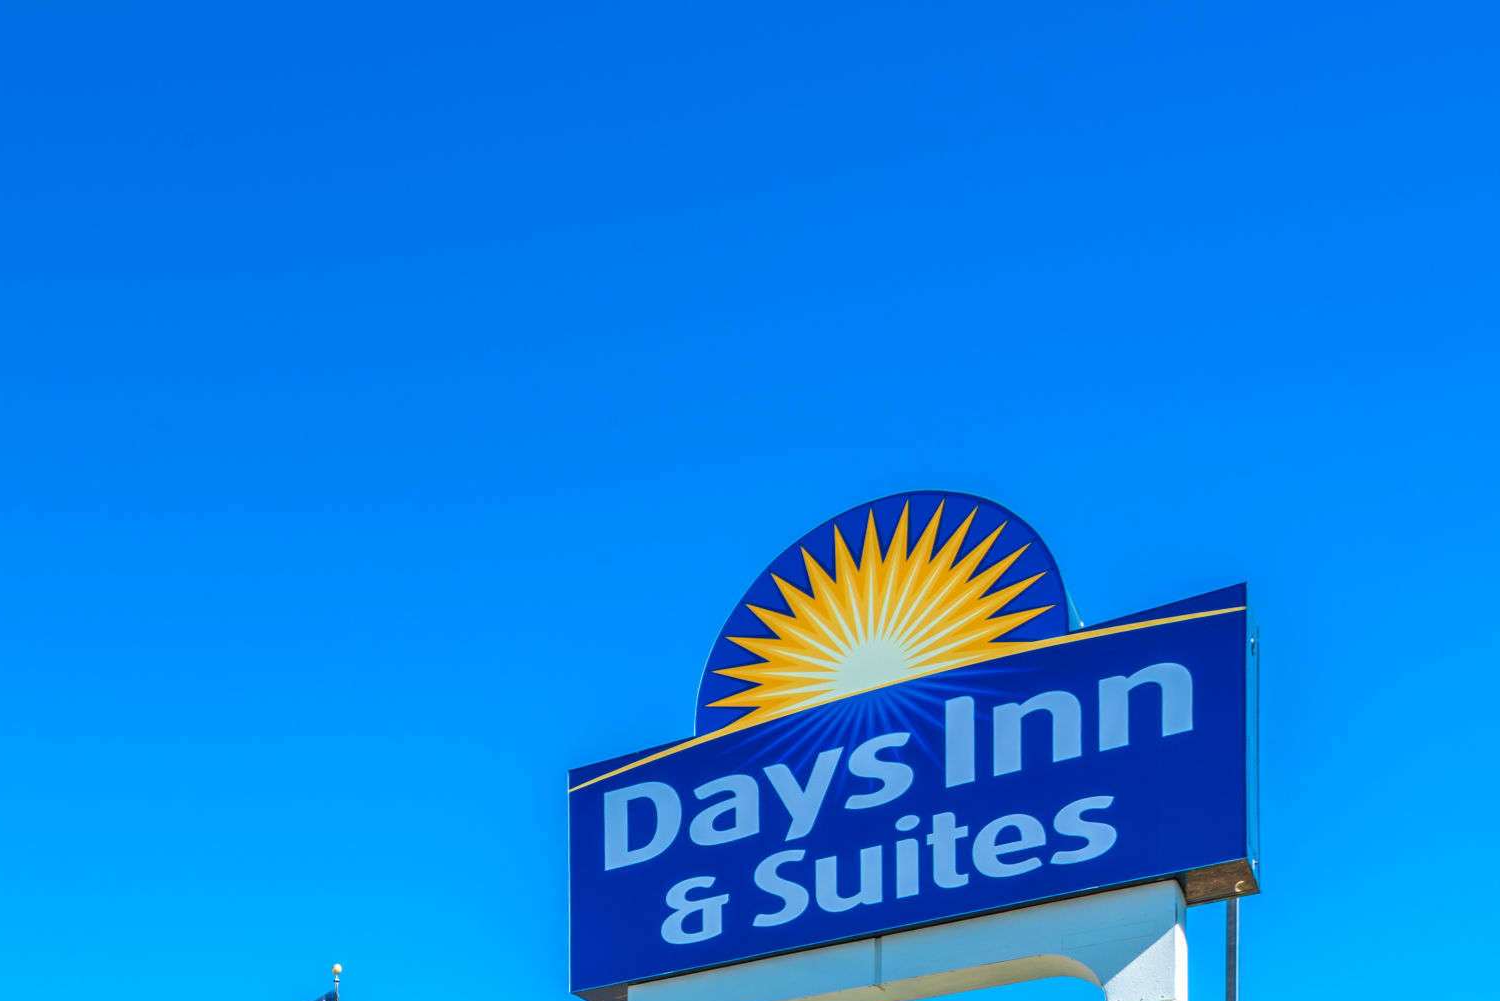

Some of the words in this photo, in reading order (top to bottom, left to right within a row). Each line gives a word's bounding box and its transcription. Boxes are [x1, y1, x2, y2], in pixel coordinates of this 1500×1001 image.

[604, 733, 913, 870] Days
[946, 662, 1192, 787] Inn
[661, 877, 729, 944] &
[753, 796, 1116, 926] Suites
